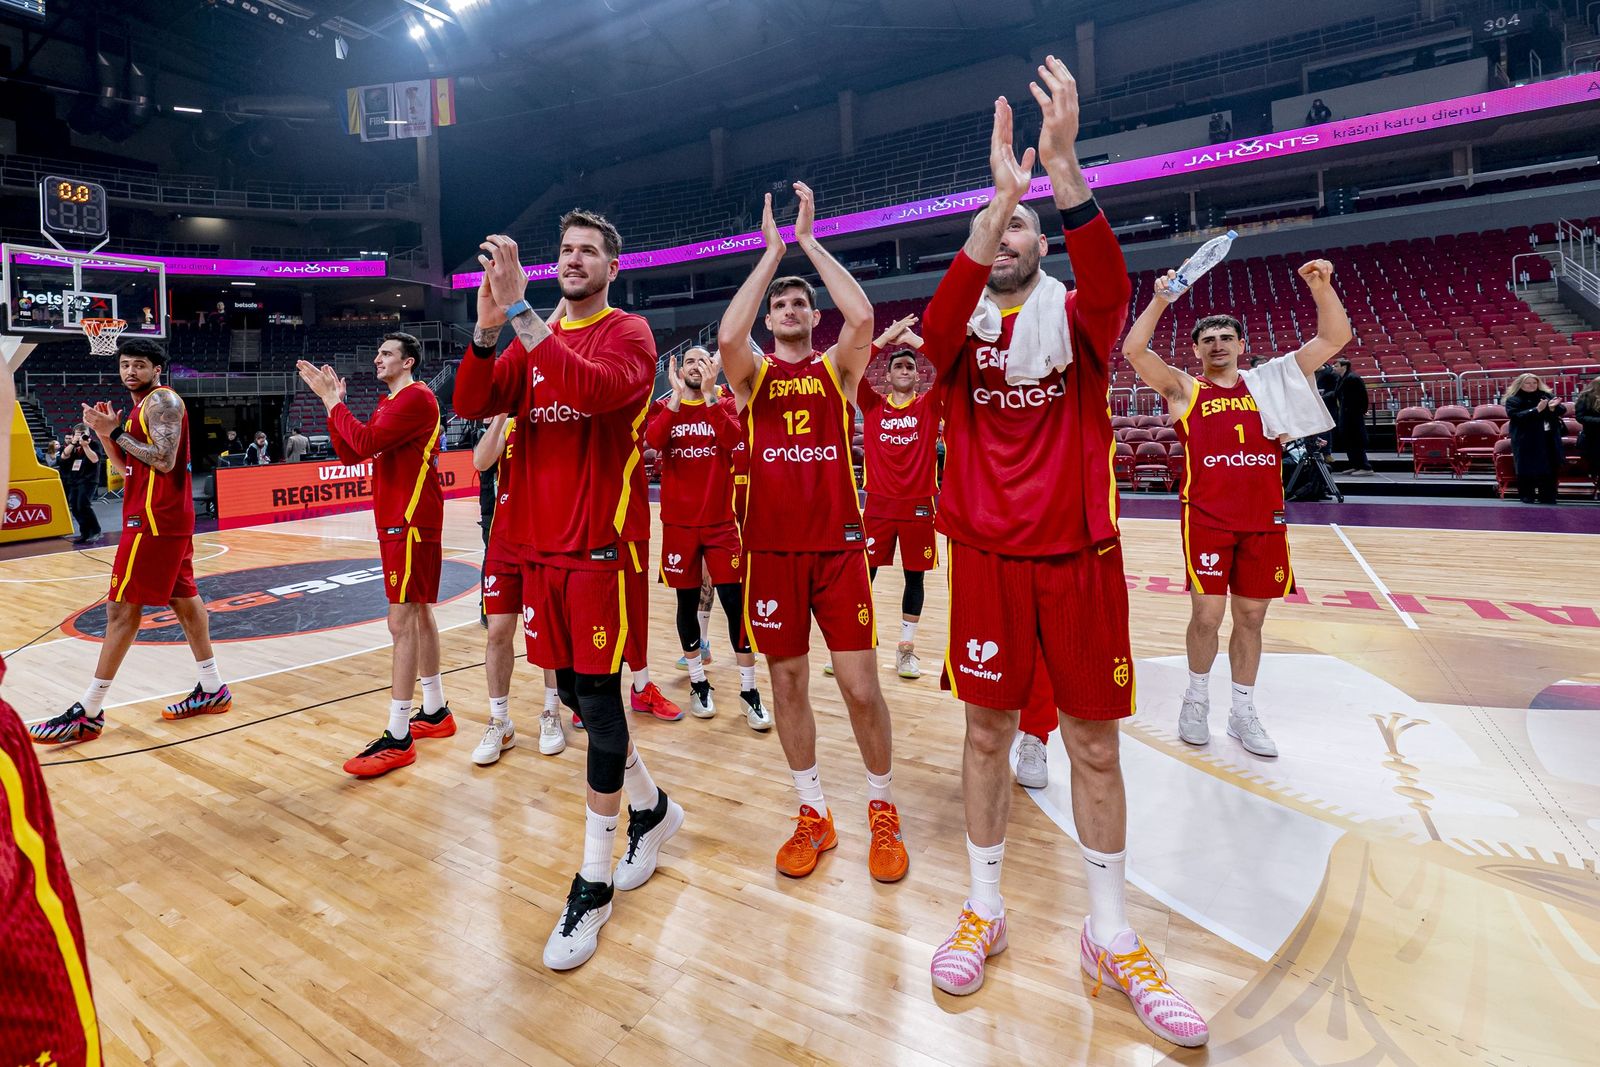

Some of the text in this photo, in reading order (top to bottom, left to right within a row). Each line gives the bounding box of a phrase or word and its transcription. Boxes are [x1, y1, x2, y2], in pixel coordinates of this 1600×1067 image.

[1483, 13, 1521, 32] 304
[1587, 81, 1600, 93] A
[1161, 160, 1177, 171] Ar
[1384, 114, 1426, 131] katru
[1432, 101, 1487, 121] dienu!
[769, 376, 827, 400] ESPAÑA
[1201, 394, 1259, 418] ESPAÑ
[782, 409, 812, 436] 12
[1233, 423, 1246, 444] 1
[762, 444, 838, 463] endesa
[1203, 450, 1277, 468] endesa
[319, 463, 366, 481] UZZINI
[3, 508, 48, 524] KAVA
